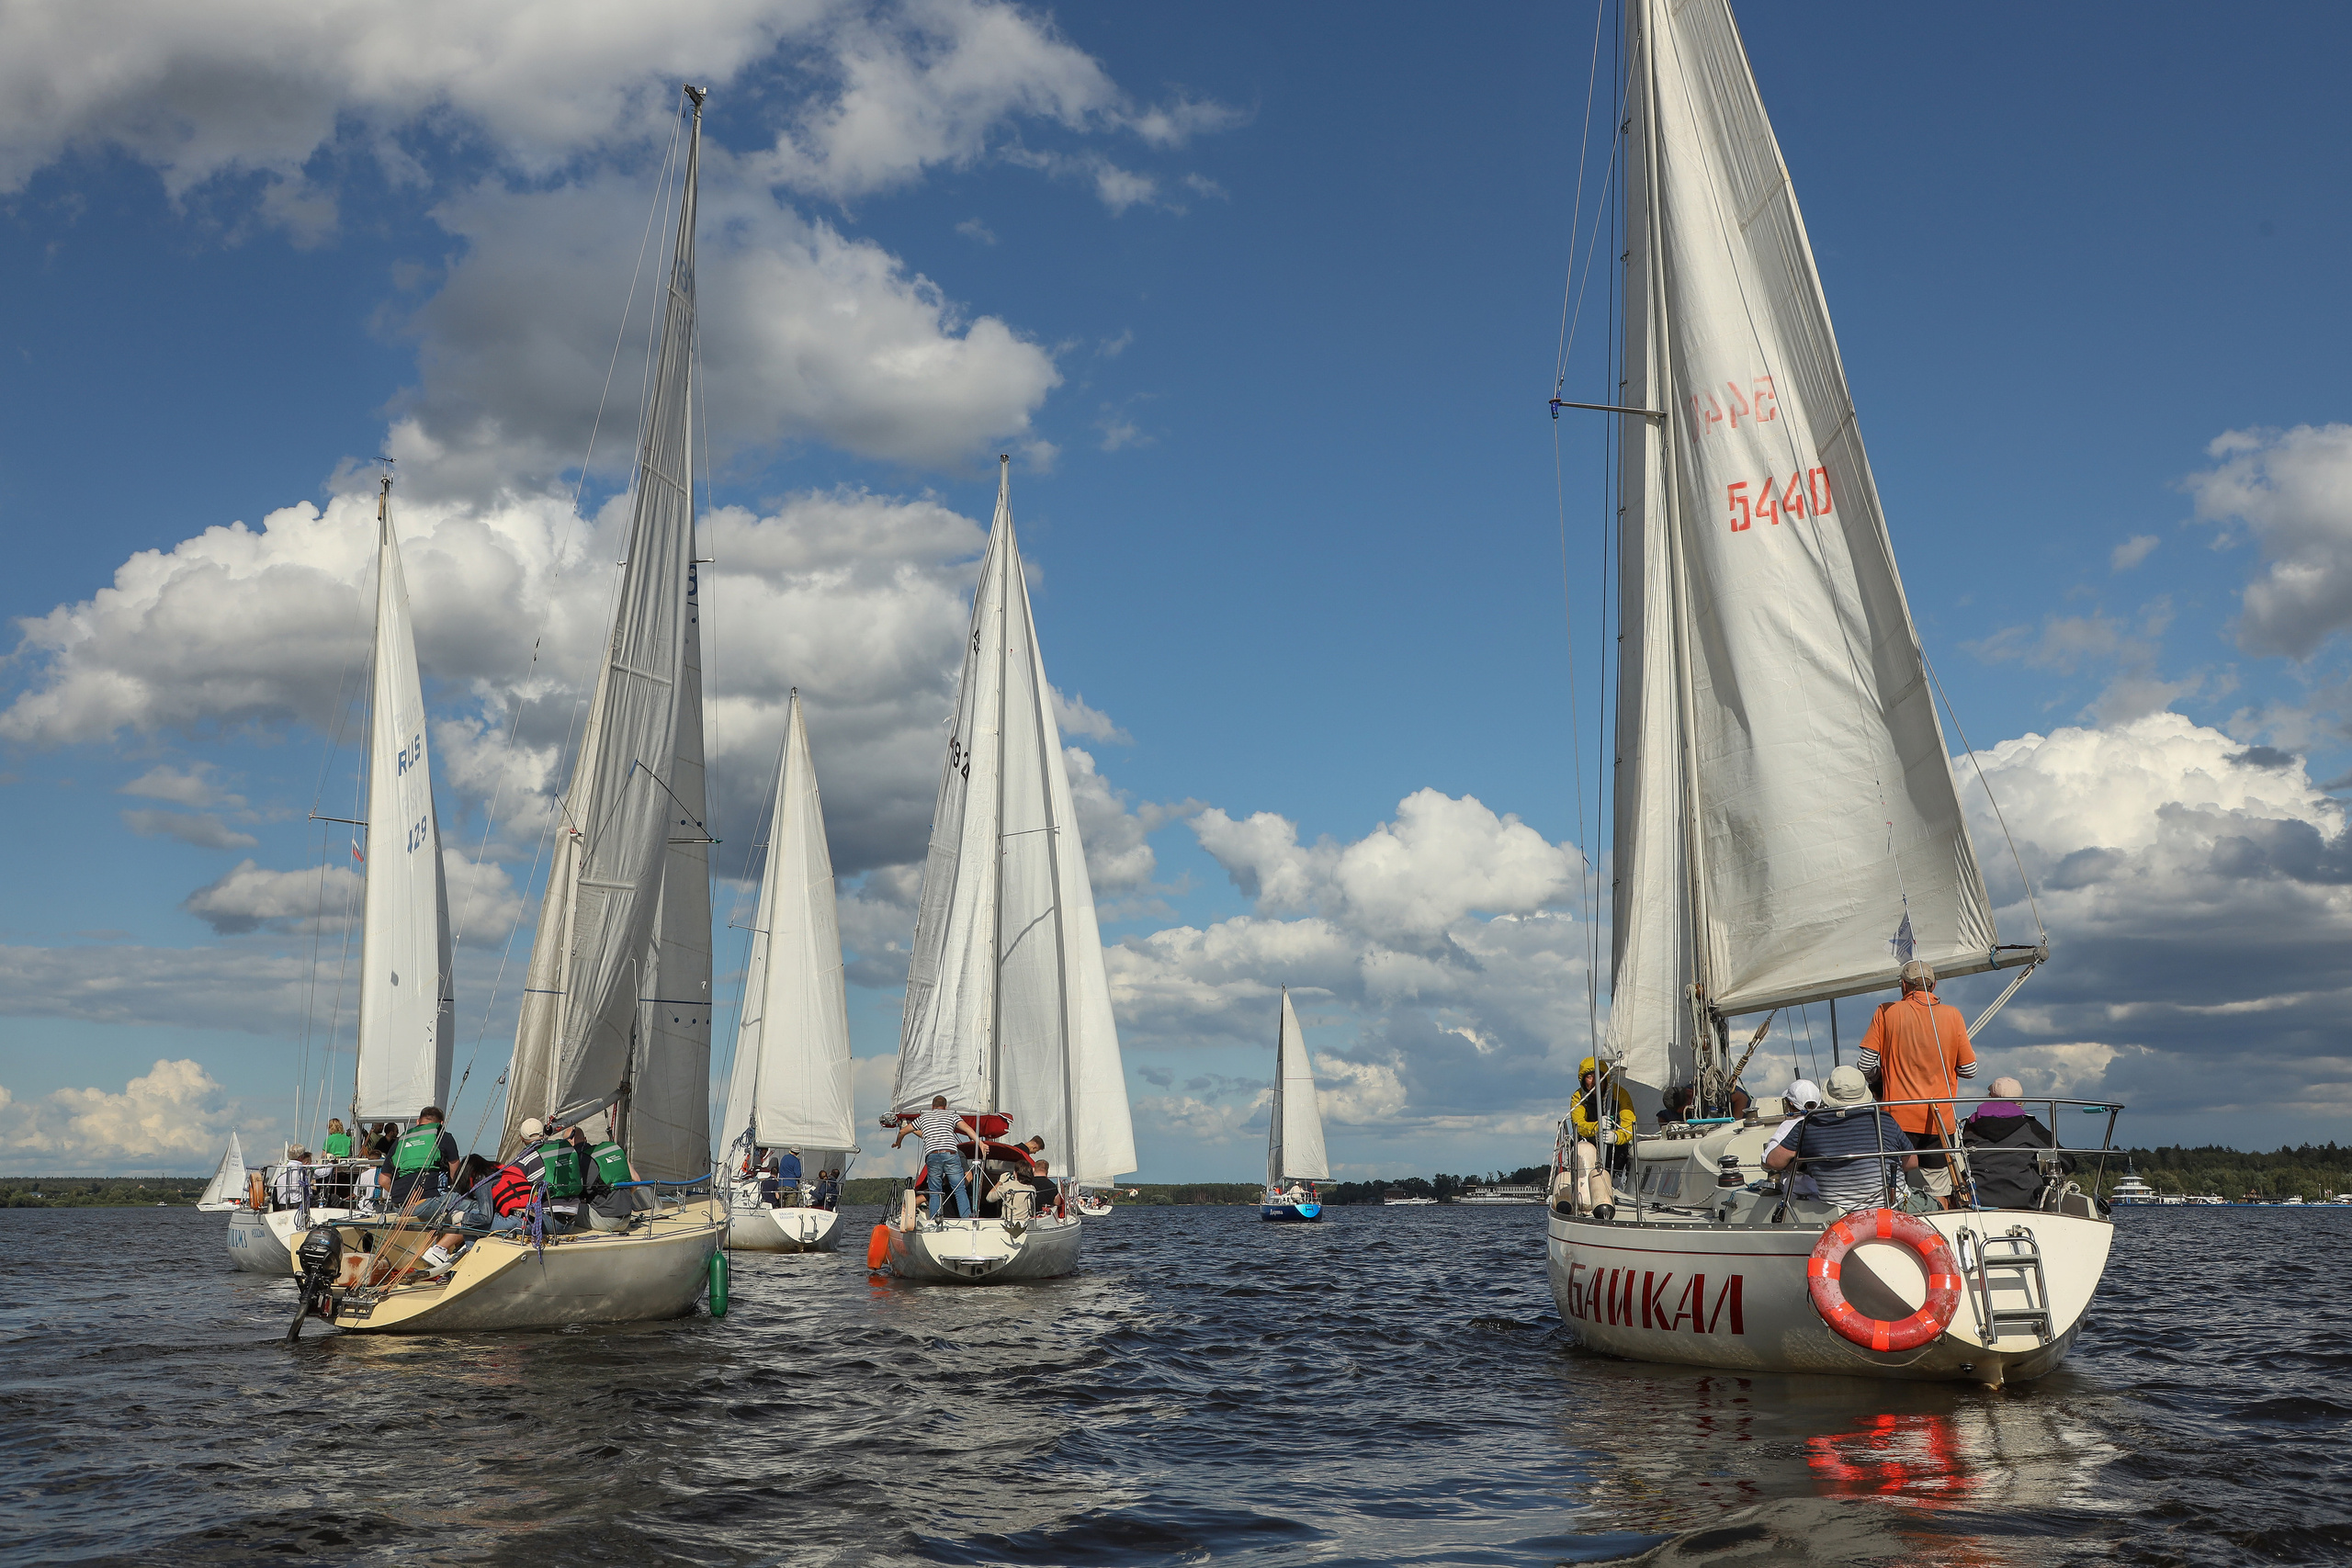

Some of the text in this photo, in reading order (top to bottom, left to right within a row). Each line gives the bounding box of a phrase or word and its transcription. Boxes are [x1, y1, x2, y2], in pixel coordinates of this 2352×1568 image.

[1727, 465, 1833, 533] 5440
[398, 733, 421, 777] RUS
[406, 815, 427, 855] 429
[1566, 1261, 1745, 1336] БАЙКАЛ
